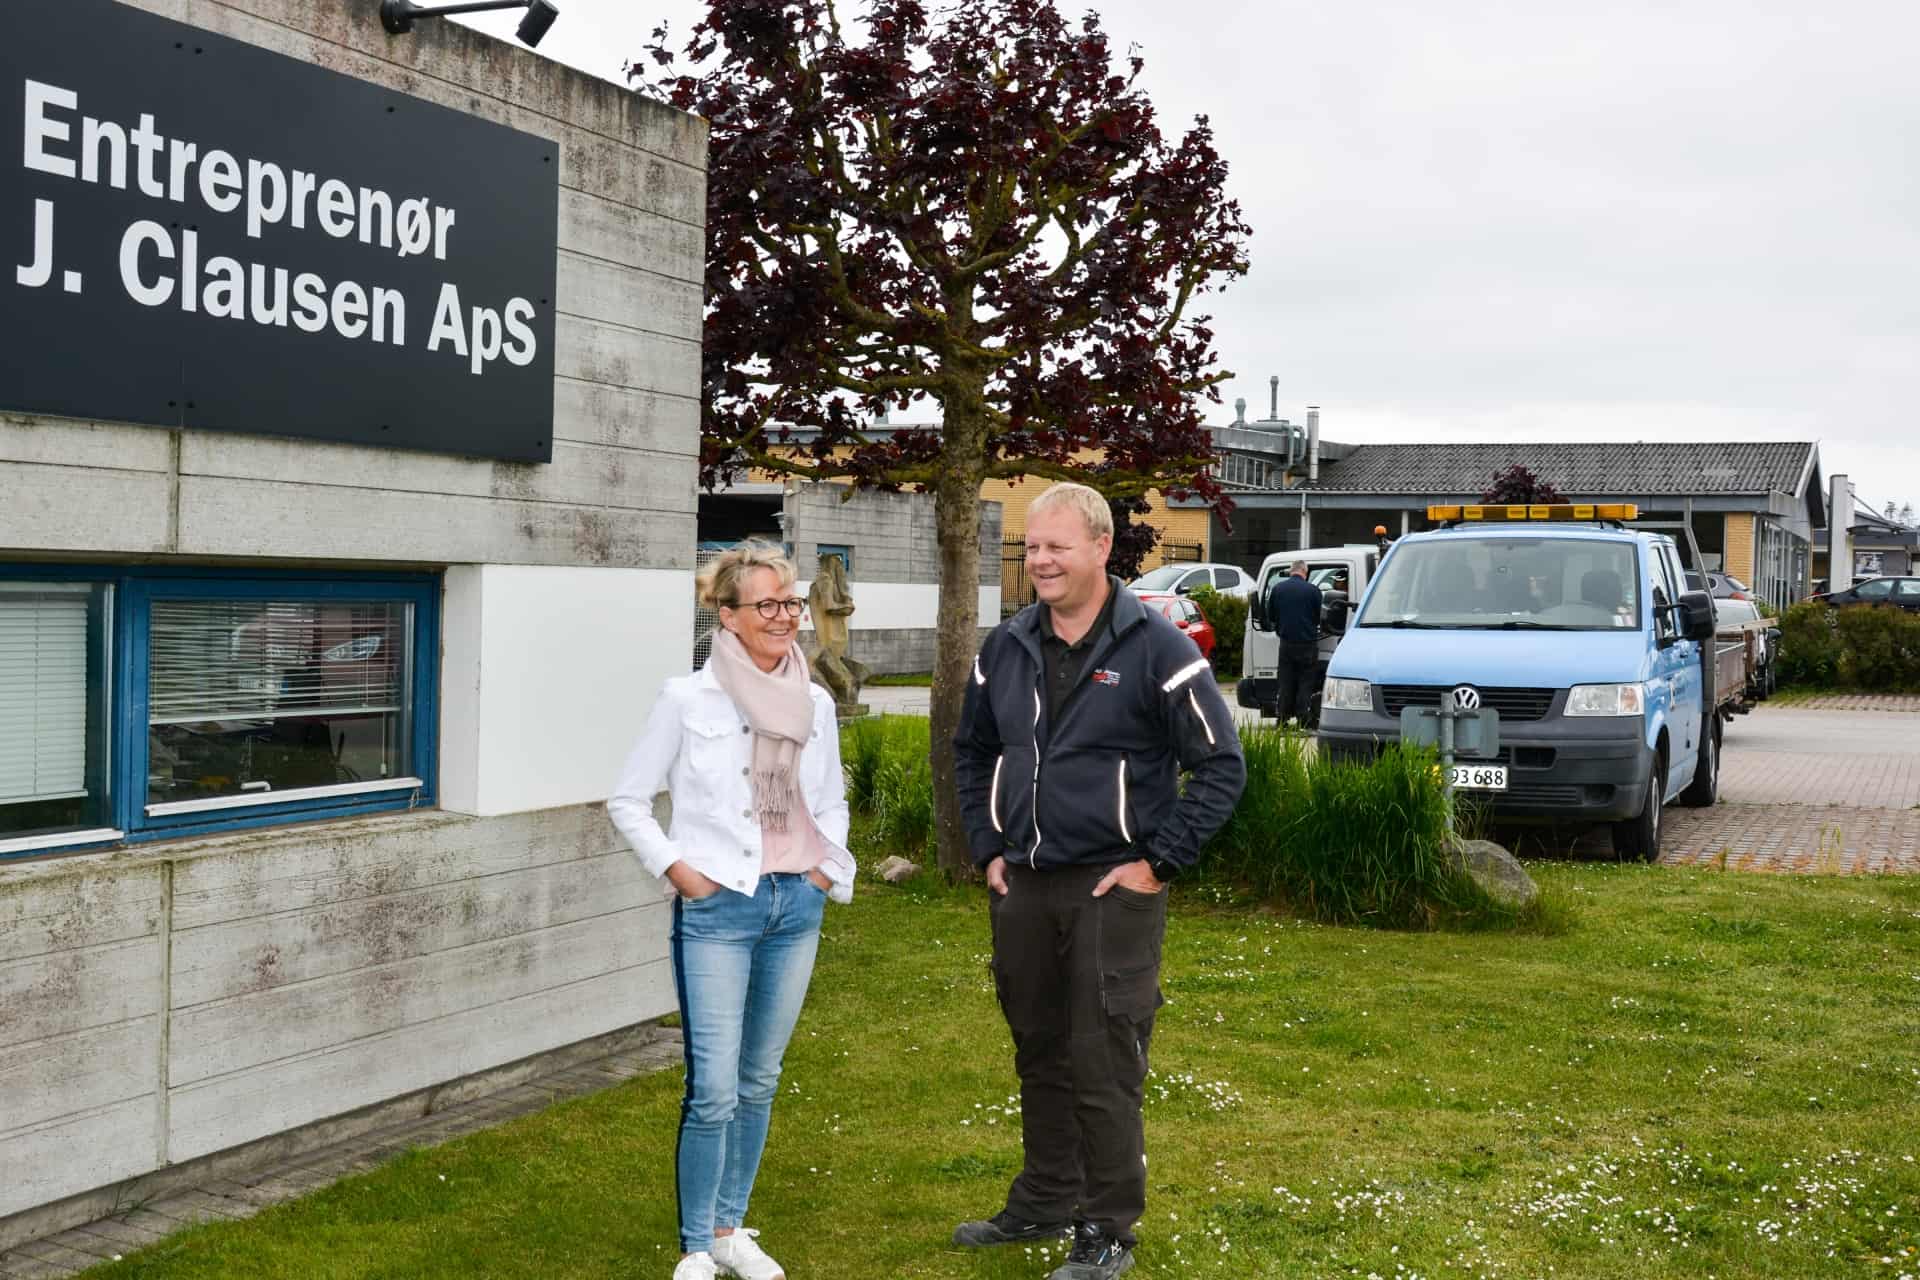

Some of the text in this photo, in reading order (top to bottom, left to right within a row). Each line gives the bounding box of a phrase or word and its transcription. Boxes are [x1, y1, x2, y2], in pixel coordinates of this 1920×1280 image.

[24, 80, 455, 259] Entreprenør
[16, 198, 537, 375] J. Clausen ApS
[1474, 770, 1504, 786] 688
